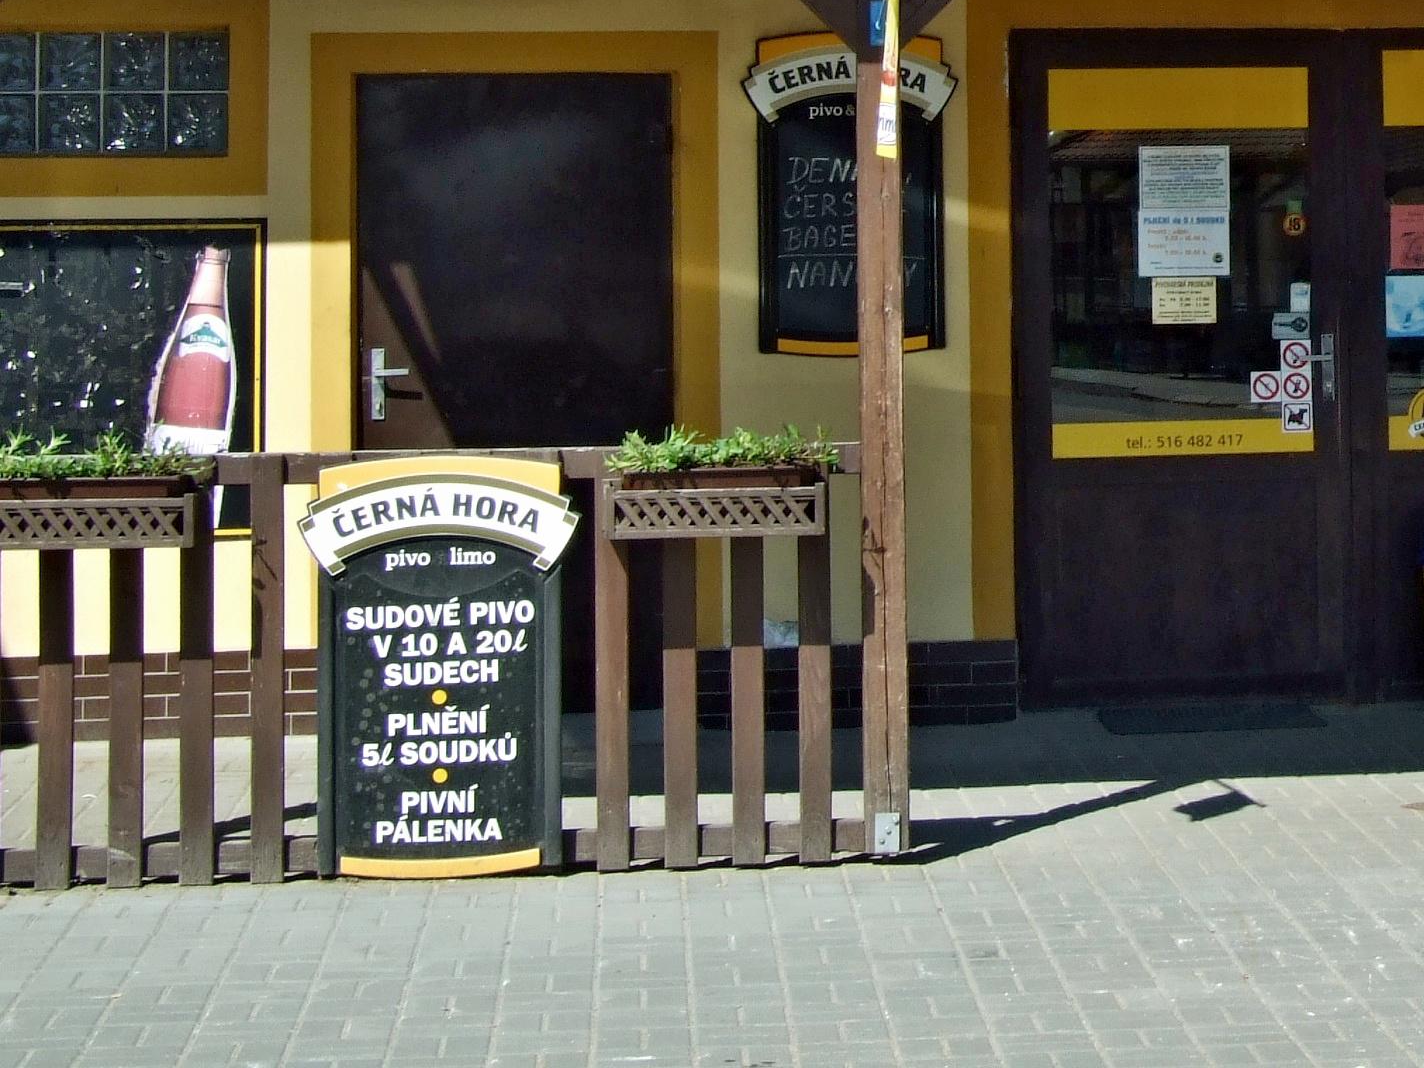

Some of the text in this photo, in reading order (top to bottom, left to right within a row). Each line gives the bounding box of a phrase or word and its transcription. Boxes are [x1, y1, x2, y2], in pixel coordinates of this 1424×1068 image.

[768, 56, 852, 95] ČERNÁ
[809, 102, 855, 120] pivo &
[786, 157, 858, 184] DEN
[783, 184, 857, 219] ČERS
[781, 224, 857, 252] BAGE
[1126, 434, 1243, 449] tel.: 516 482 417
[332, 488, 539, 538] ČERNÁ HORA
[384, 547, 496, 571] pivo limo
[345, 597, 535, 630] SUDOVÉ PIVO
[372, 634, 392, 659] V
[401, 633, 438, 657] 10
[446, 632, 467, 655] A
[383, 659, 500, 687] SUDECH
[387, 704, 490, 737] PLNĚNÍ
[399, 732, 518, 766] SOUDKŮ
[400, 784, 479, 814] PIVNÍ
[375, 814, 503, 844] PÁLENKA
